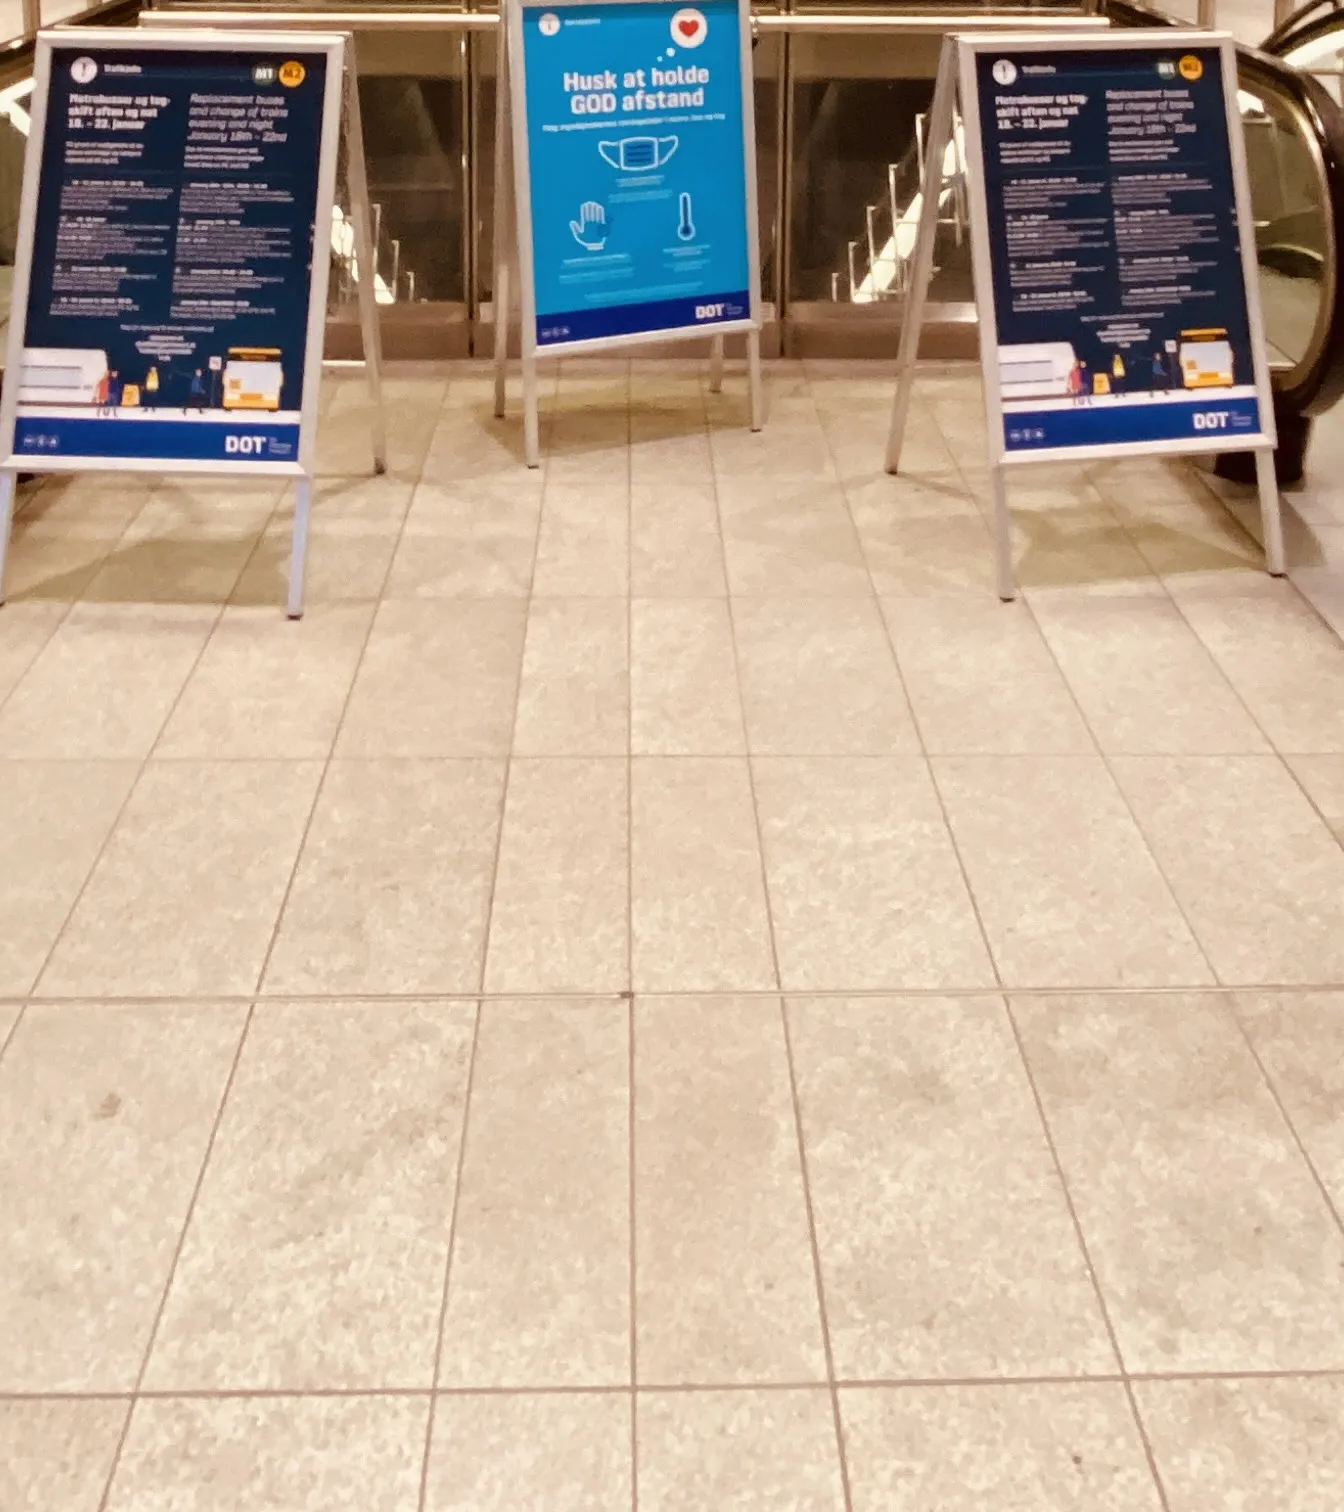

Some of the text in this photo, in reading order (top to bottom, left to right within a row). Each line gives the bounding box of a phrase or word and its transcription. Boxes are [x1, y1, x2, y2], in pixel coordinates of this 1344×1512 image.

[256, 67, 273, 79] M1
[563, 65, 710, 92] Husk at holde
[570, 88, 705, 115] GOD afstand
[695, 303, 725, 320] DOT
[1192, 411, 1229, 430] DOT
[224, 435, 267, 454] DOT
